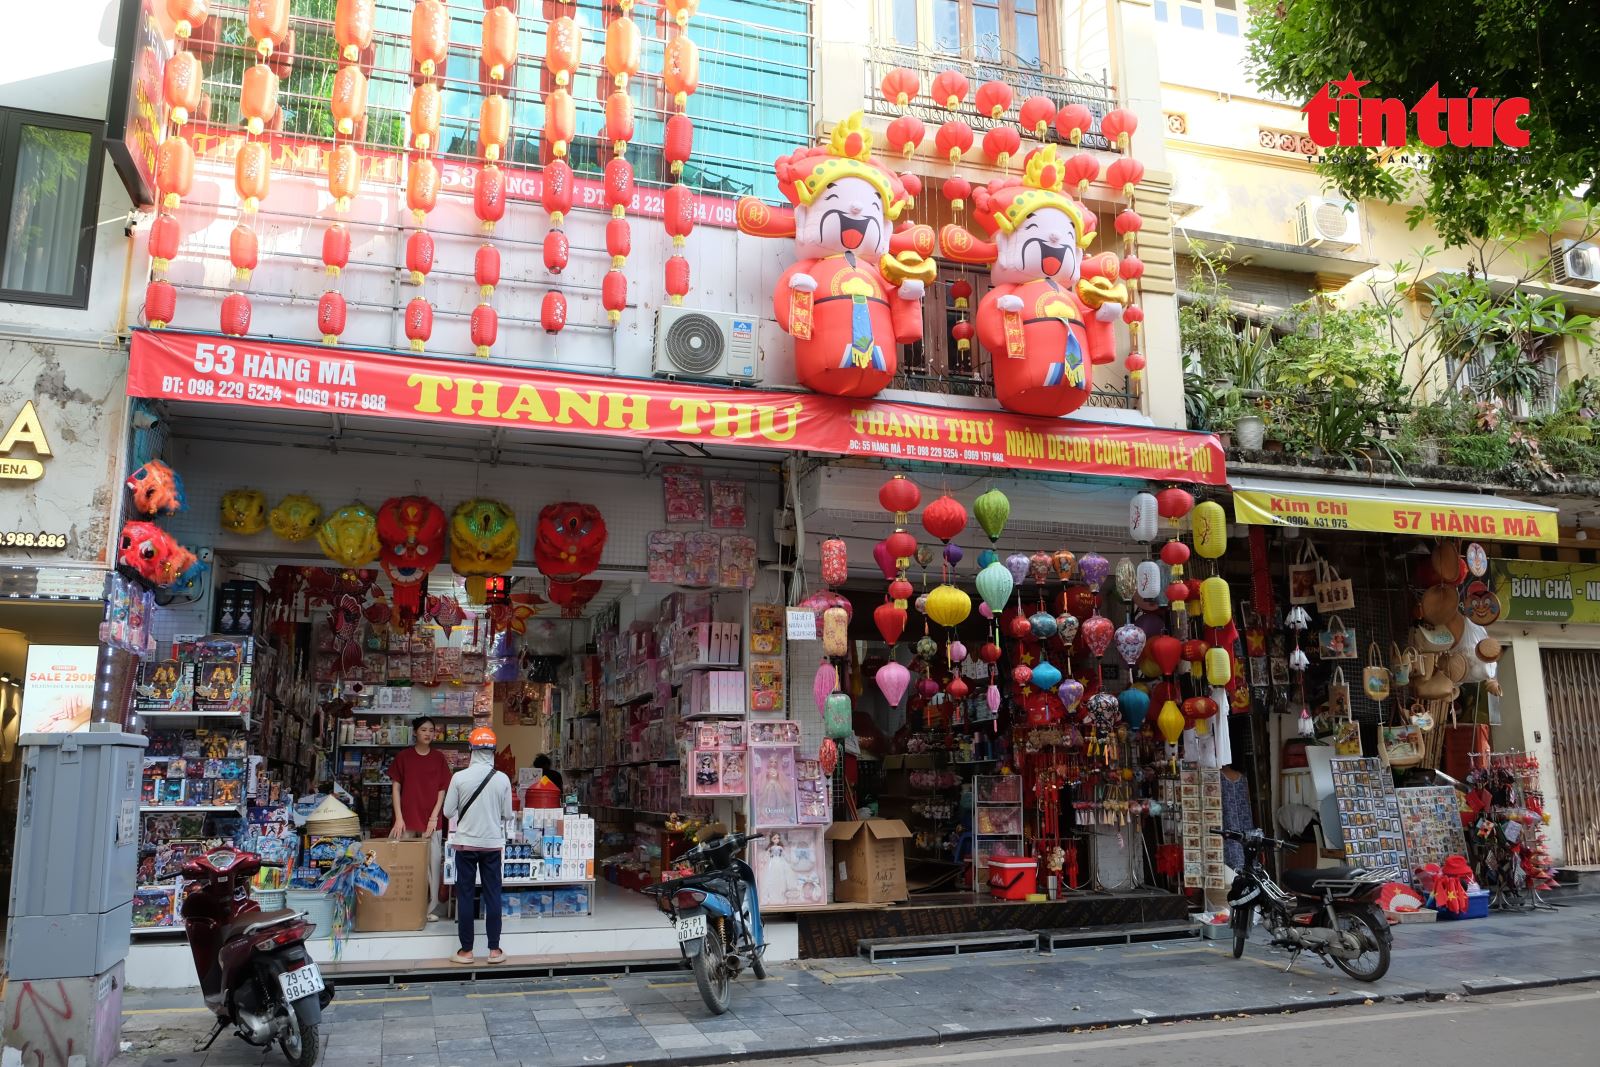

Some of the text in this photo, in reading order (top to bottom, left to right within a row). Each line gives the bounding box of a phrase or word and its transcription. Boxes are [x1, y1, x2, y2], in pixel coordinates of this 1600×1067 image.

[194, 343, 356, 387] 53 HÀNG MÃ
[162, 376, 184, 394] ĐT:
[188, 379, 213, 397] 098
[218, 382, 244, 399] 229
[248, 384, 282, 402] 5254
[295, 388, 329, 407] 0969
[333, 391, 356, 408] 157
[361, 393, 386, 411] 988
[407, 373, 804, 442] THANH THƯ
[851, 409, 994, 446] THANH THƯ
[862, 440, 871, 451] 55
[930, 448, 942, 457] 229
[943, 448, 959, 459] 5254
[980, 452, 991, 461] 157
[1005, 427, 1045, 464] NHẬN
[1047, 433, 1092, 463] DECOR
[1093, 434, 1130, 467] CÔNG
[1131, 438, 1172, 470] TRÌNH
[1190, 443, 1213, 479] HỘI
[0, 464, 28, 475] ENA
[1270, 495, 1348, 516] Kim Chi
[1314, 517, 1328, 527] 431
[1331, 518, 1348, 528] 075
[1393, 509, 1543, 538] 57 HÀNG MÃ
[0, 532, 66, 548] .988.886
[1511, 574, 1541, 598] BÚN
[1545, 574, 1573, 600] CHẢ
[30, 672, 62, 682] SALE
[680, 917, 702, 930] 25-P1
[286, 967, 314, 986] 29-C1
